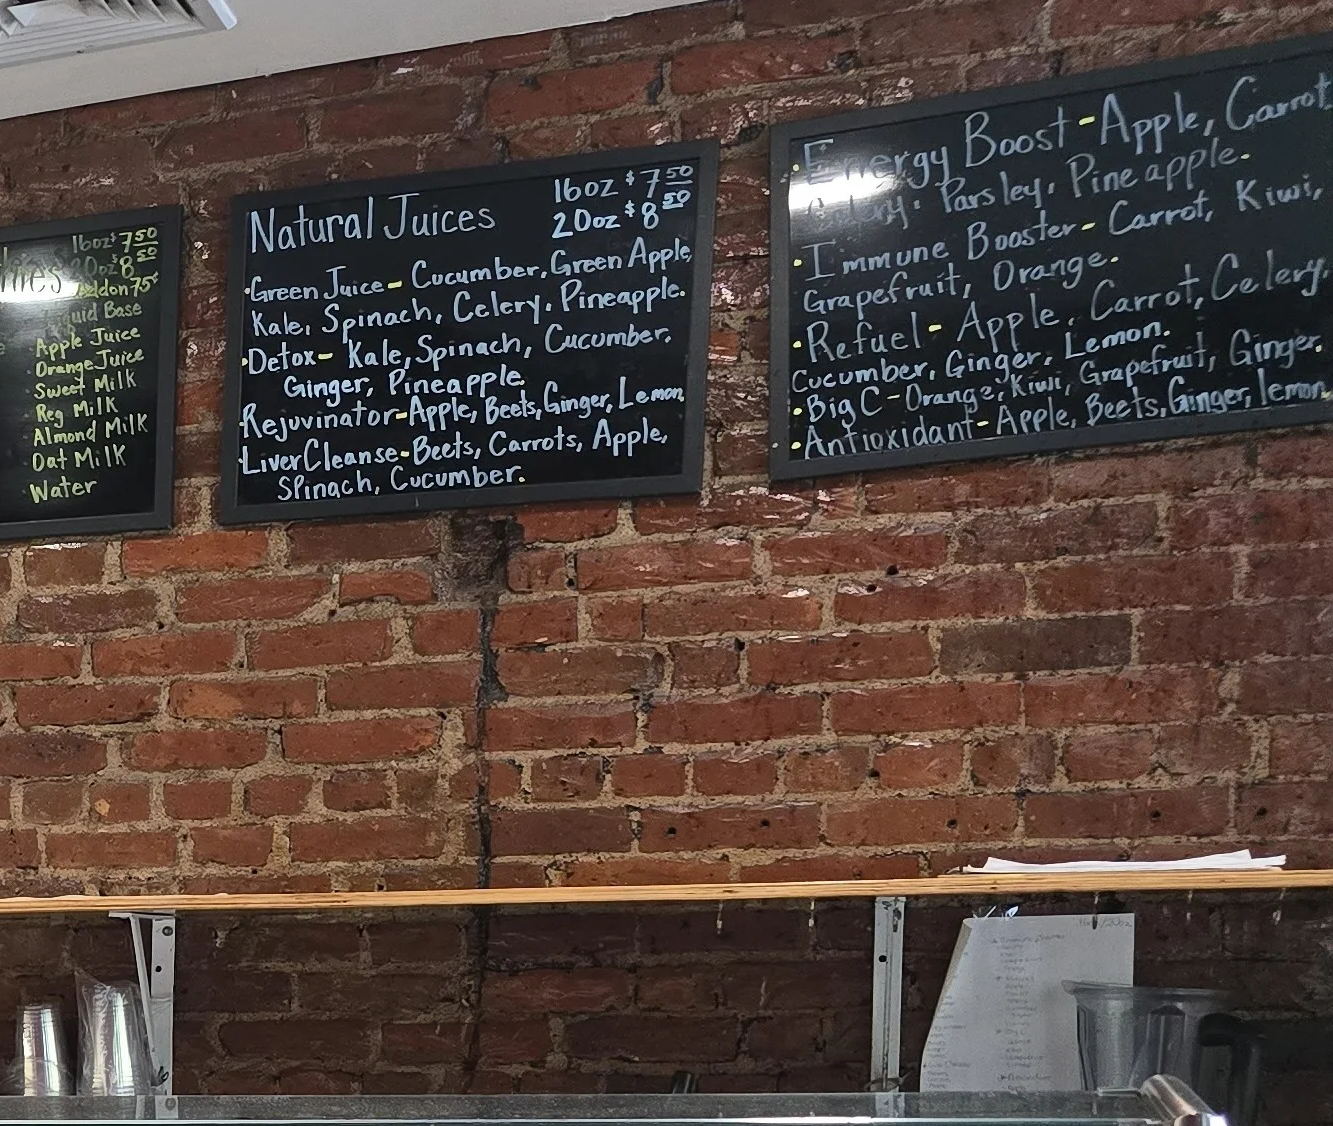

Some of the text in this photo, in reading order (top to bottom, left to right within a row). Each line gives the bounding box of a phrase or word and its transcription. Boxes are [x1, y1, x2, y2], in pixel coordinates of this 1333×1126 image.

[251, 196, 374, 253] Natural
[383, 193, 496, 240] Juices
[250, 275, 319, 302] Green
[550, 249, 622, 276] Green
[801, 239, 949, 281] Immune
[36, 327, 141, 361] Apple Juice
[36, 349, 145, 381] Orange Juice
[34, 382, 85, 399] Sweet
[806, 393, 857, 429] Big
[34, 420, 96, 446] Almond
[33, 448, 67, 472] Oat
[30, 476, 97, 503] Water
